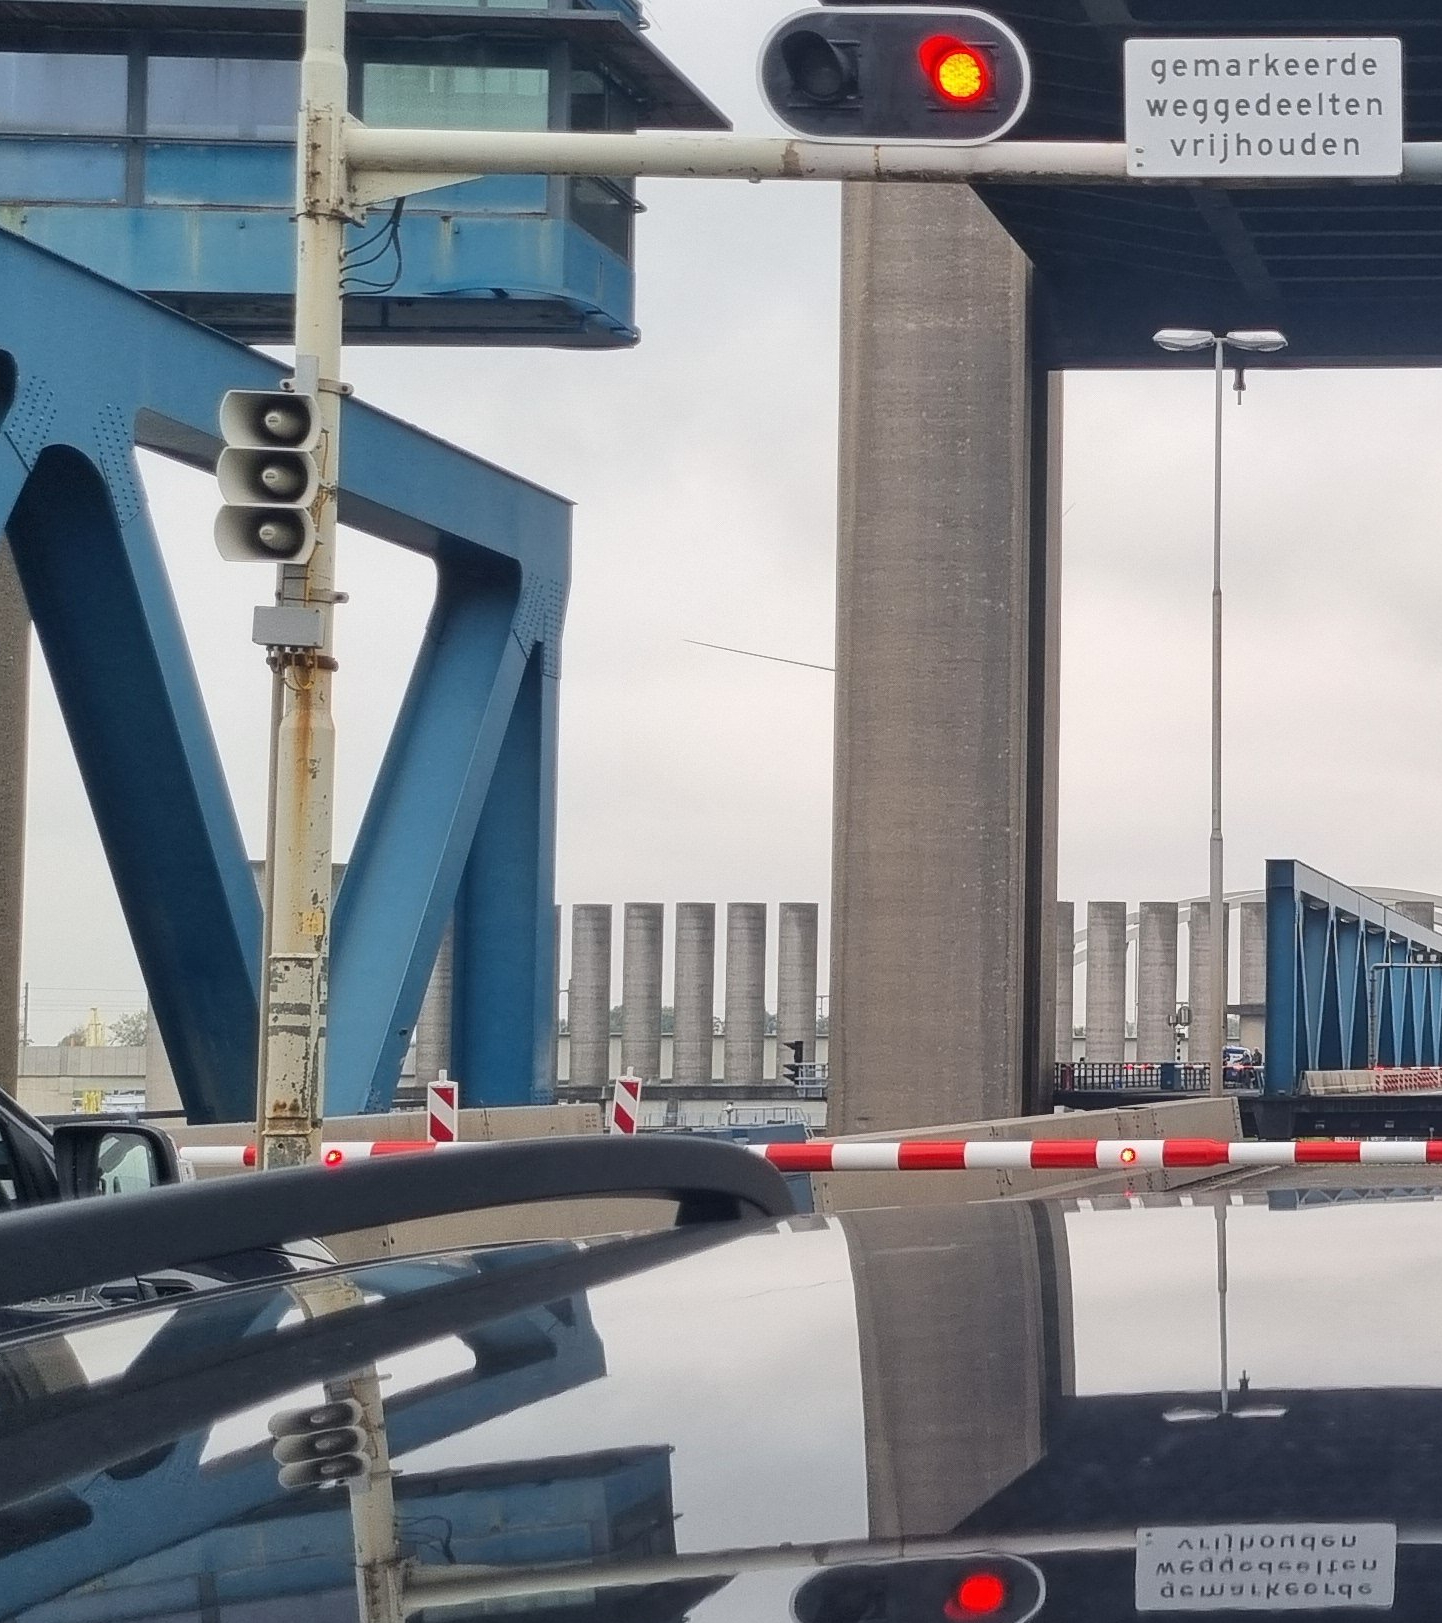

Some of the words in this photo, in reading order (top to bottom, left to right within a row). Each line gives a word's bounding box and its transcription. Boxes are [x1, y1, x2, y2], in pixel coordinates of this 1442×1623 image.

[1150, 52, 1378, 84] gemarkeerde
[1146, 92, 1383, 124] weggedeelten
[1170, 132, 1361, 164] vrijhouden
